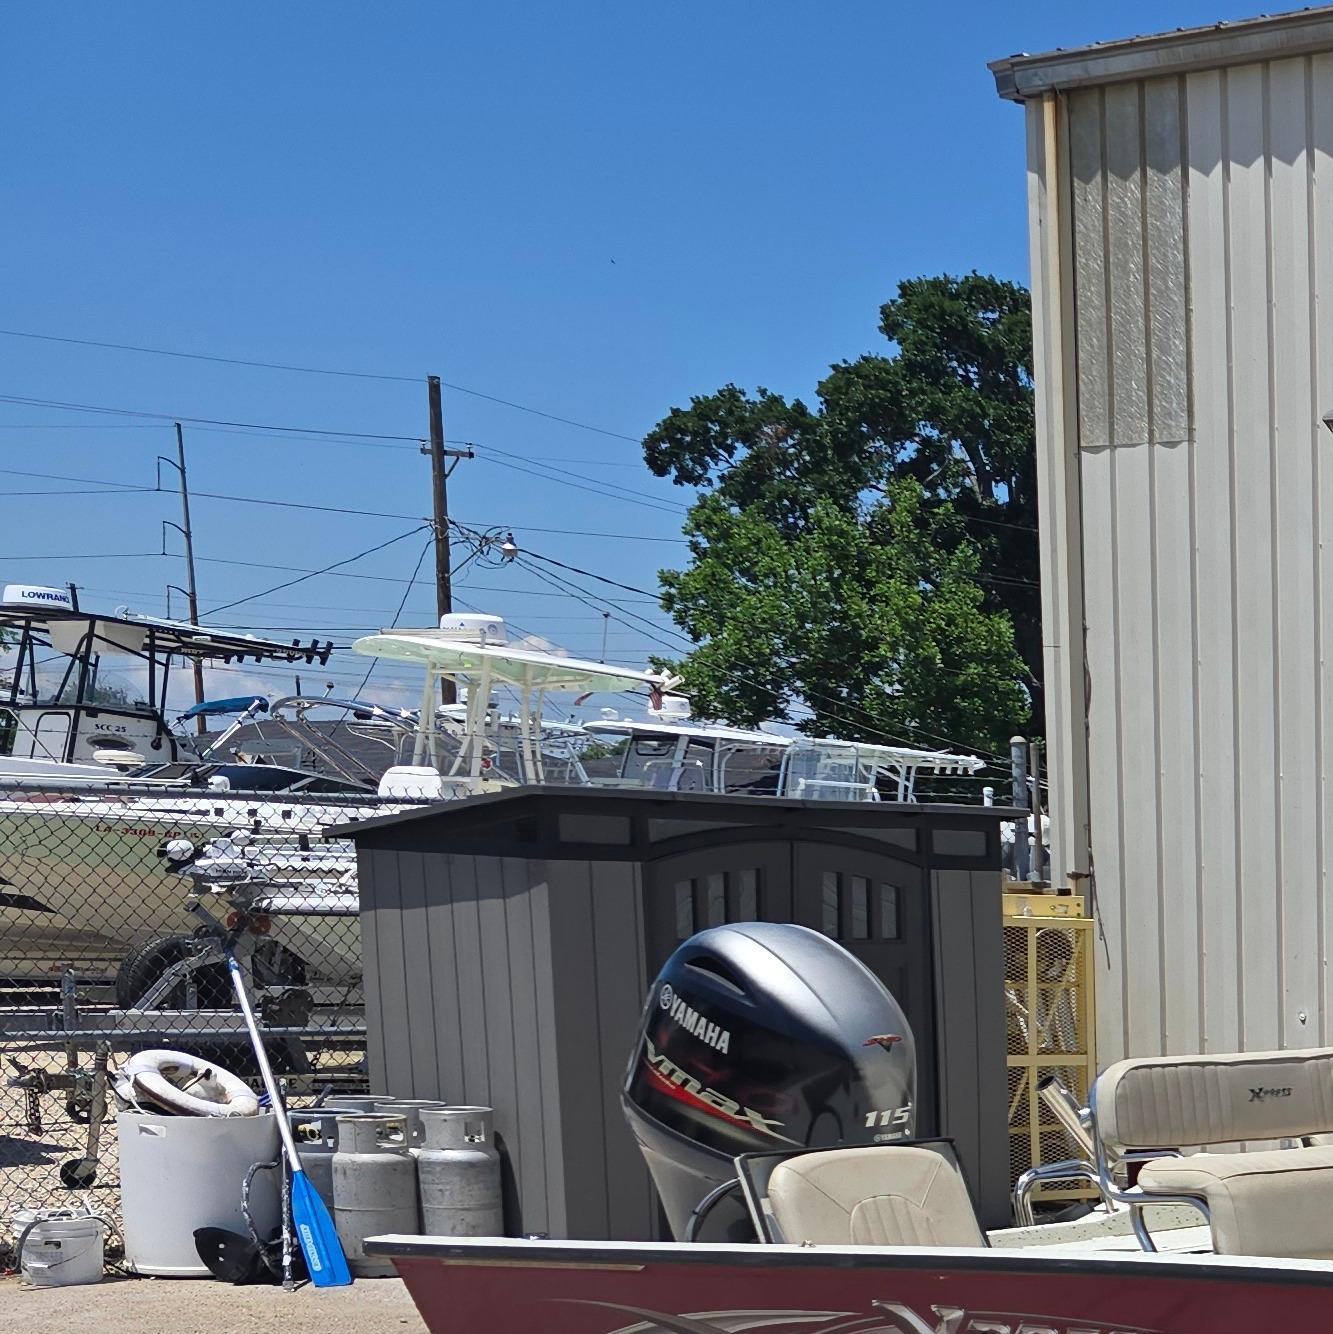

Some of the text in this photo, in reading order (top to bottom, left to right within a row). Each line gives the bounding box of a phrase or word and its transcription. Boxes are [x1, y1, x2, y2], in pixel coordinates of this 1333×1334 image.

[21, 590, 70, 604] LOWRANC
[669, 993, 731, 1055] YAMAHA
[864, 1106, 911, 1128] 115
